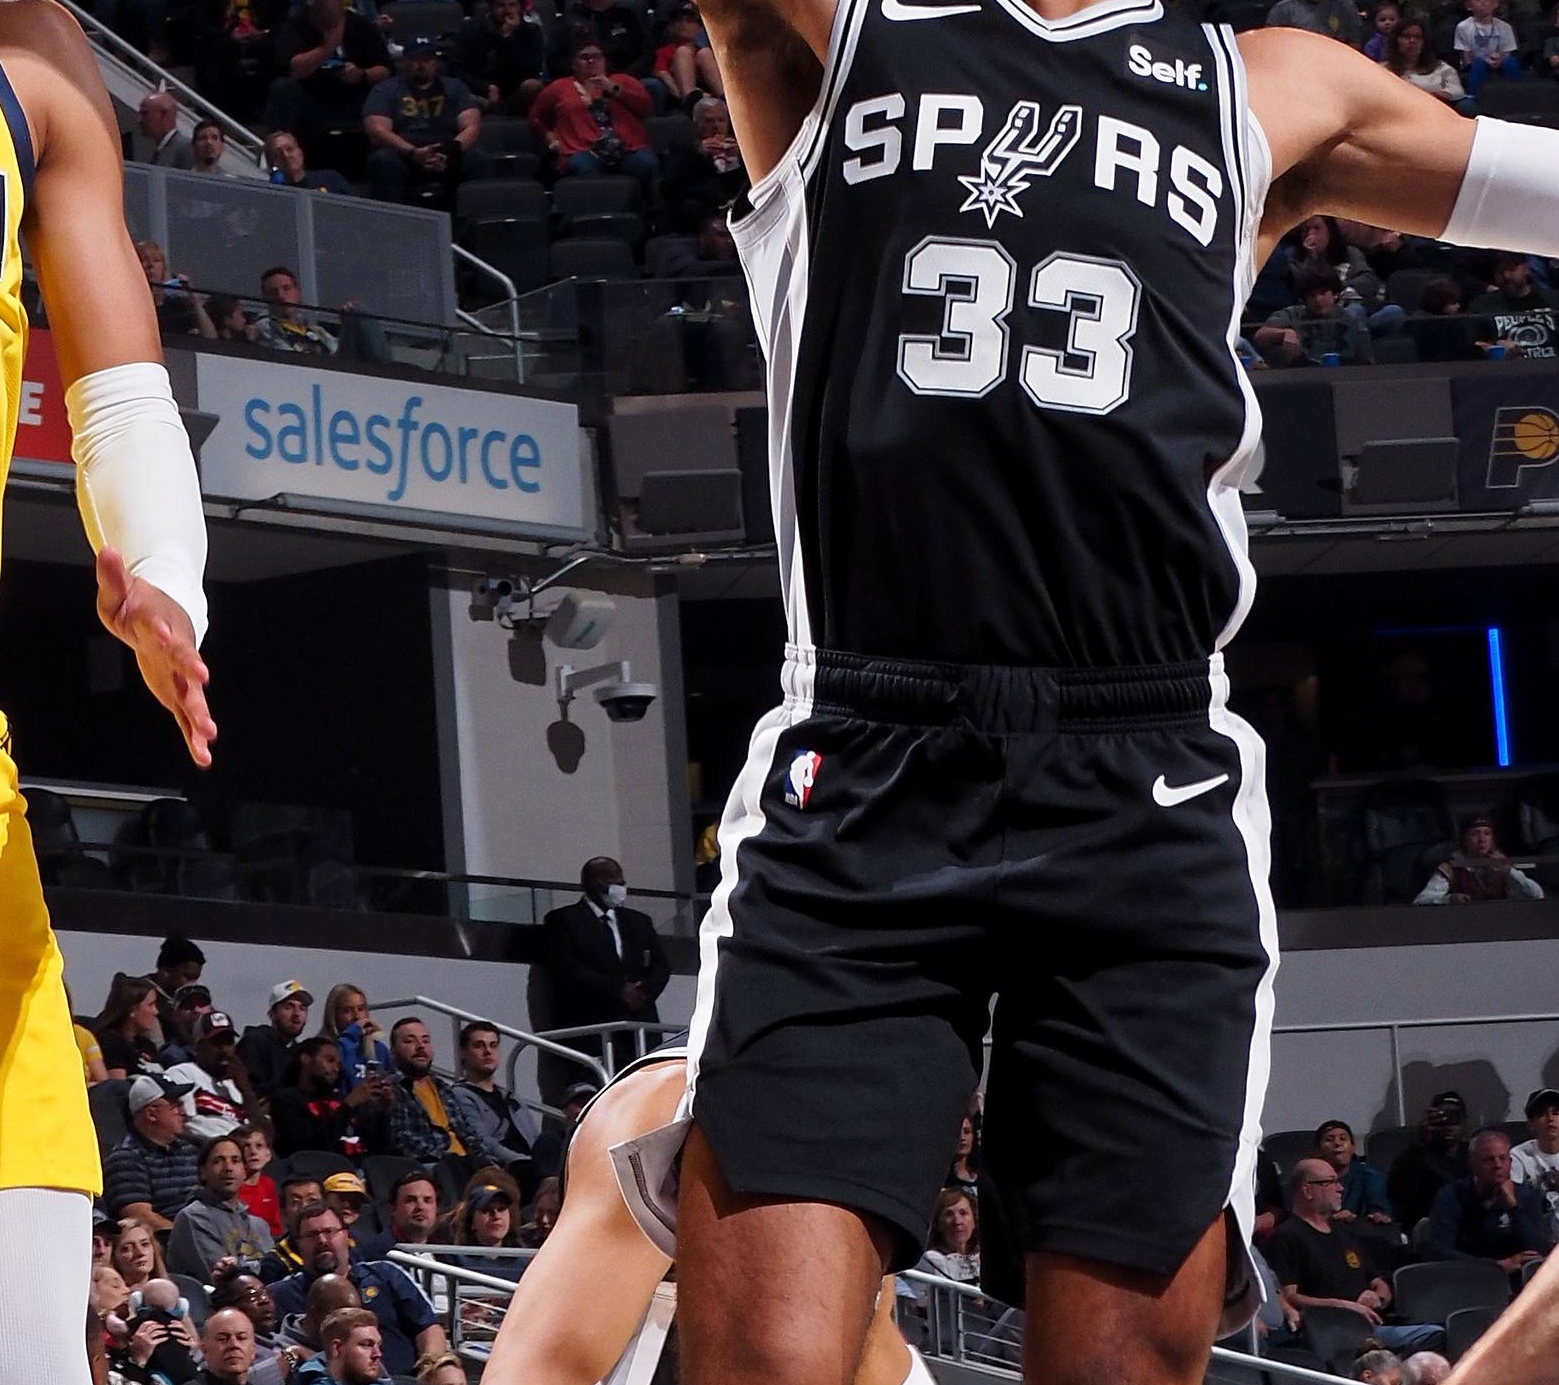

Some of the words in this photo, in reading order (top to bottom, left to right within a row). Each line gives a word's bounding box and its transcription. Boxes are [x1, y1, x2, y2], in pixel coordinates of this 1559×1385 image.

[1128, 45, 1208, 92] Self.
[842, 92, 1224, 248] SPURS
[896, 235, 1143, 416] 33
[244, 383, 543, 502] salesforce
